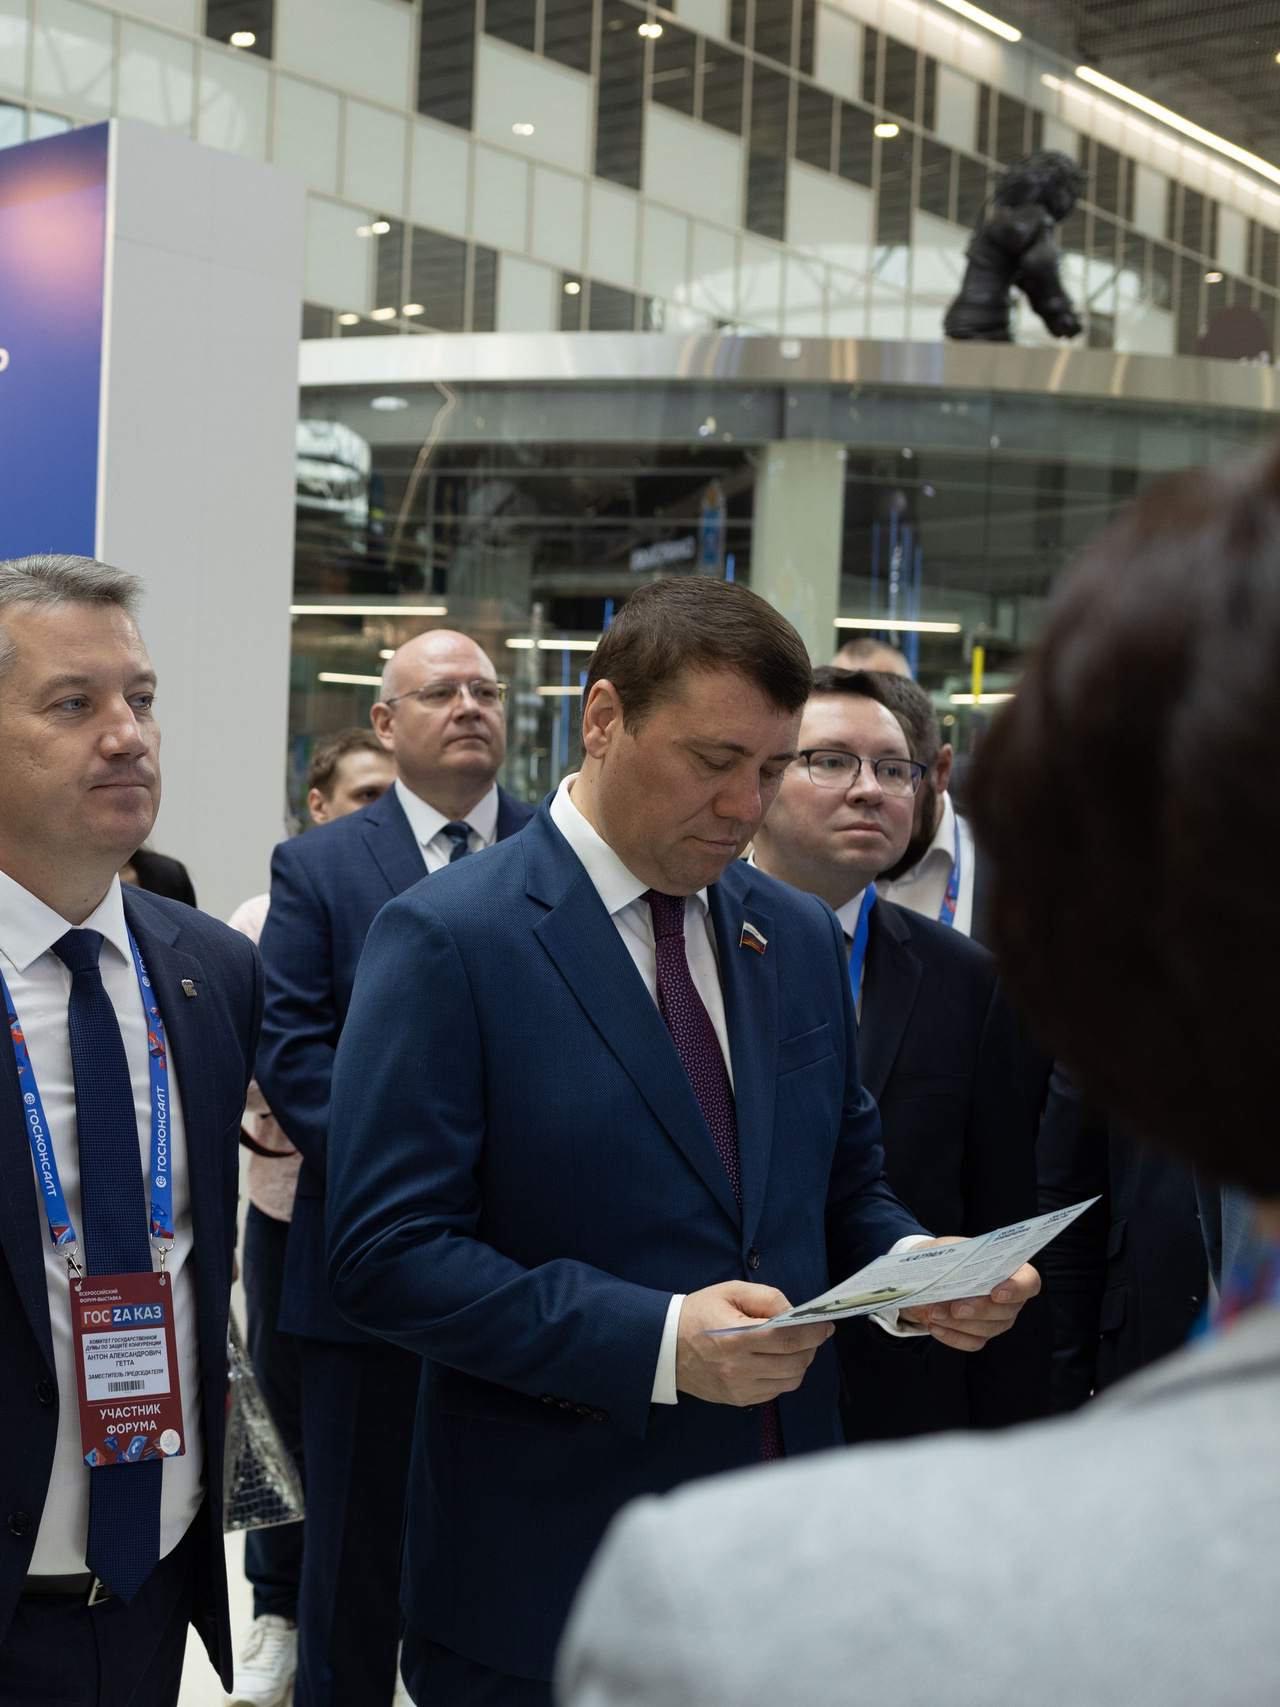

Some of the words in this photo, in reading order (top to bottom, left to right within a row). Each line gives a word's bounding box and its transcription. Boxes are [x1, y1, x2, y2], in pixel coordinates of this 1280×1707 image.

[157, 1086, 166, 1172] ГОСКОНСАЛТ
[28, 1109, 57, 1197] ГОСКОНСАЛТ
[111, 1334, 157, 1343] ГОСУДАРСТВЕННОЙ
[109, 1349, 161, 1359] АЛЕКСАНДРОВИЧ
[88, 1372, 124, 1380] ЗАМЕСТИТЕЛЬ
[124, 1368, 164, 1377] ПРЕДСЕДАТЕЛЯ
[100, 1403, 161, 1420] УЧАСТНИК
[106, 1420, 157, 1435] ФОРУМА
